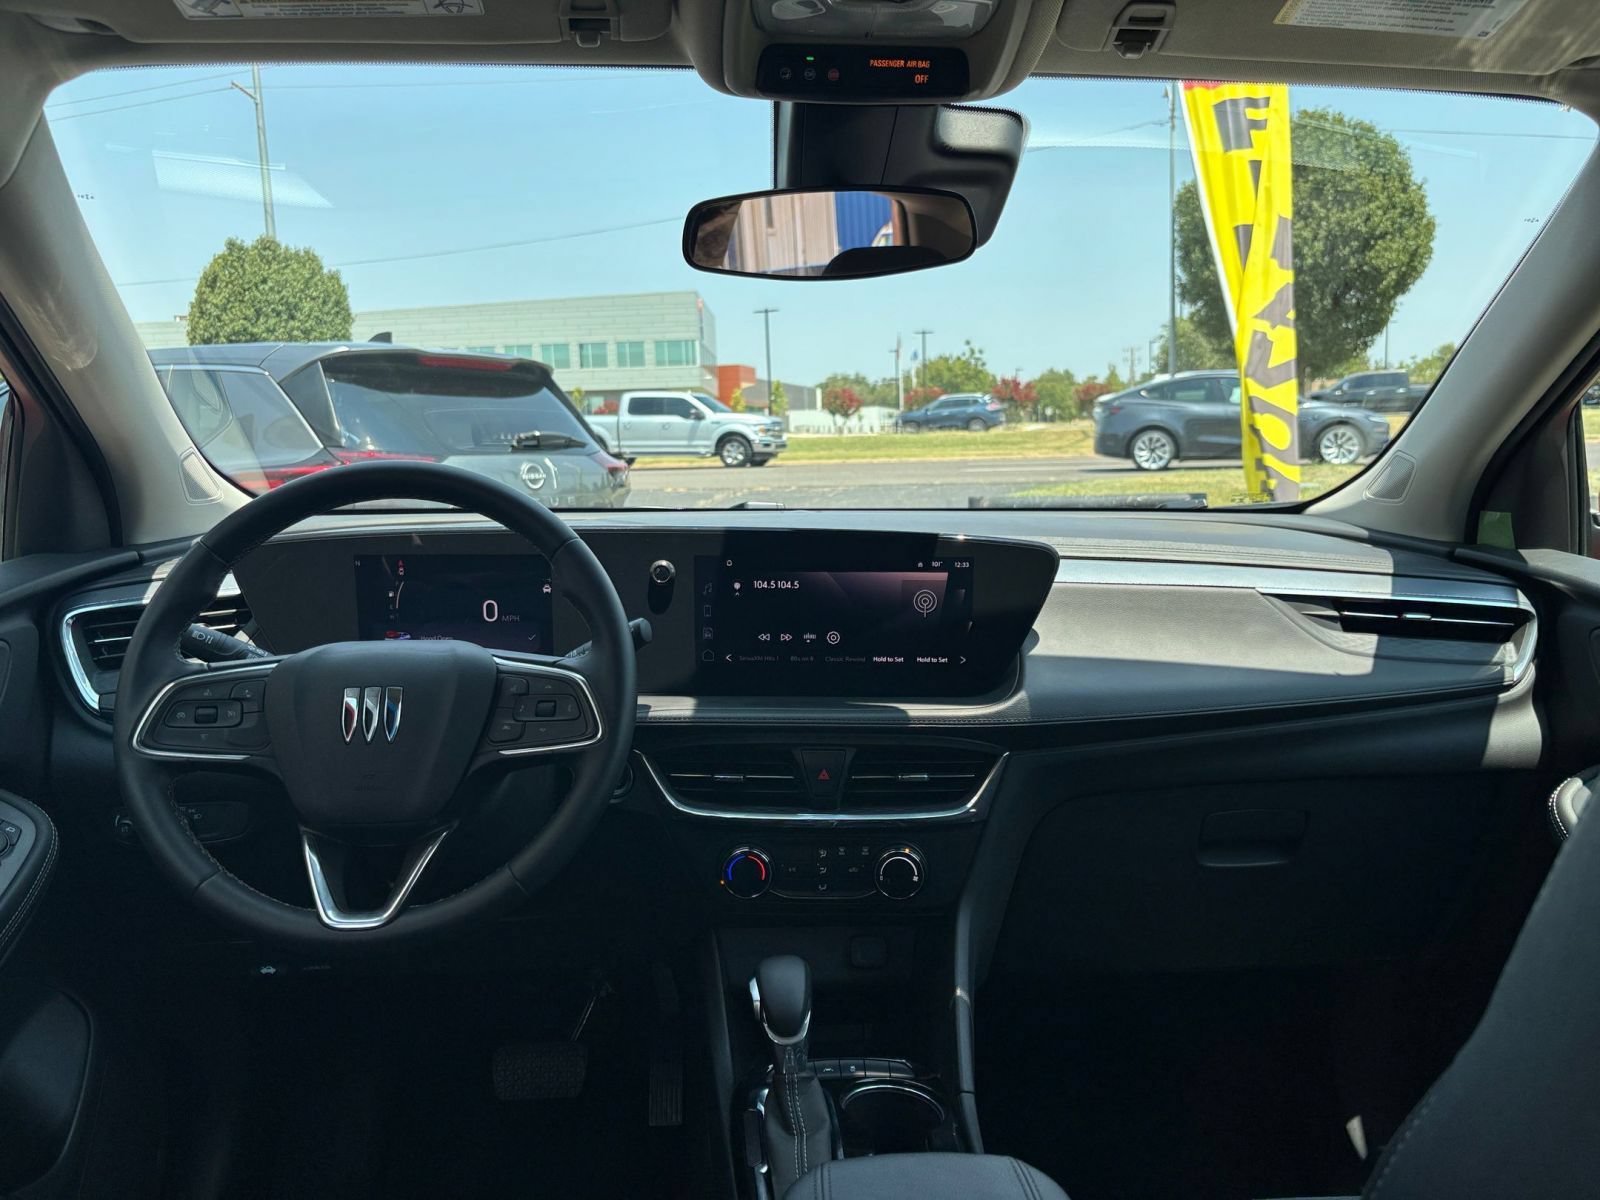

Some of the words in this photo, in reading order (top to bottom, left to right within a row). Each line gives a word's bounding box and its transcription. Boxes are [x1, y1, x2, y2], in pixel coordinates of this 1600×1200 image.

[870, 60, 905, 68] PASSENGER
[914, 74, 928, 84] OFF
[753, 580, 776, 589] 104.5
[777, 580, 800, 589] 104.5
[916, 656, 930, 664] Hold
[931, 656, 938, 664] to
[938, 656, 948, 664] Set
